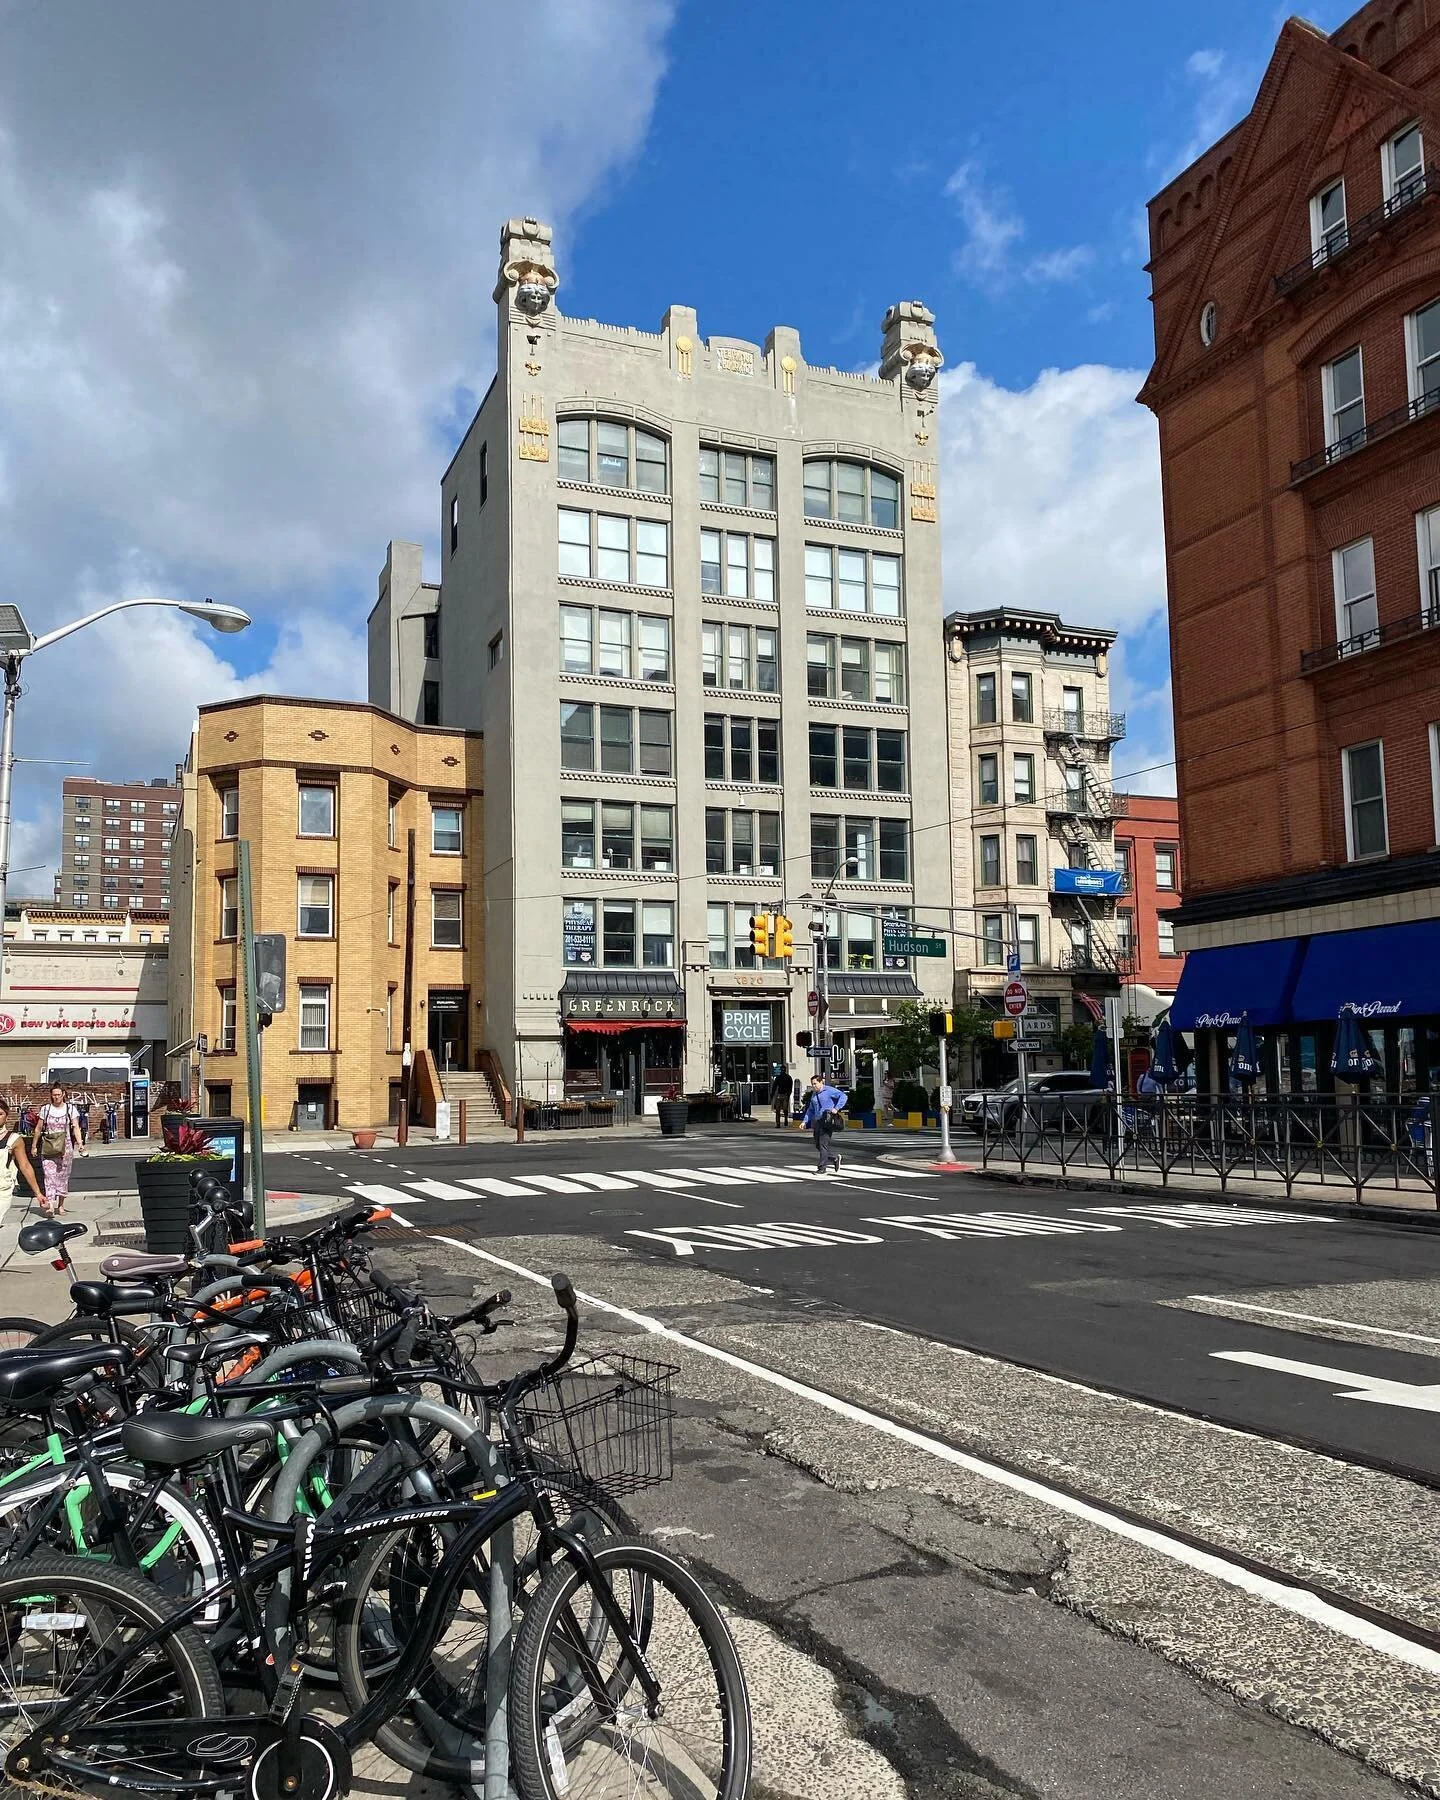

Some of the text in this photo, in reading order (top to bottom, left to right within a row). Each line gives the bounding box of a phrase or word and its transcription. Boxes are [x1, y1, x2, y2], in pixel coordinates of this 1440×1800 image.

[889, 939, 929, 953] Hudson
[46, 1019, 70, 1031] york
[72, 1020, 106, 1030] sports
[724, 1012, 770, 1025] PRIME
[724, 1026, 770, 1038] CYCLE
[624, 1222, 885, 1256] ONLY
[343, 1510, 450, 1535] EARTH CRUISER
